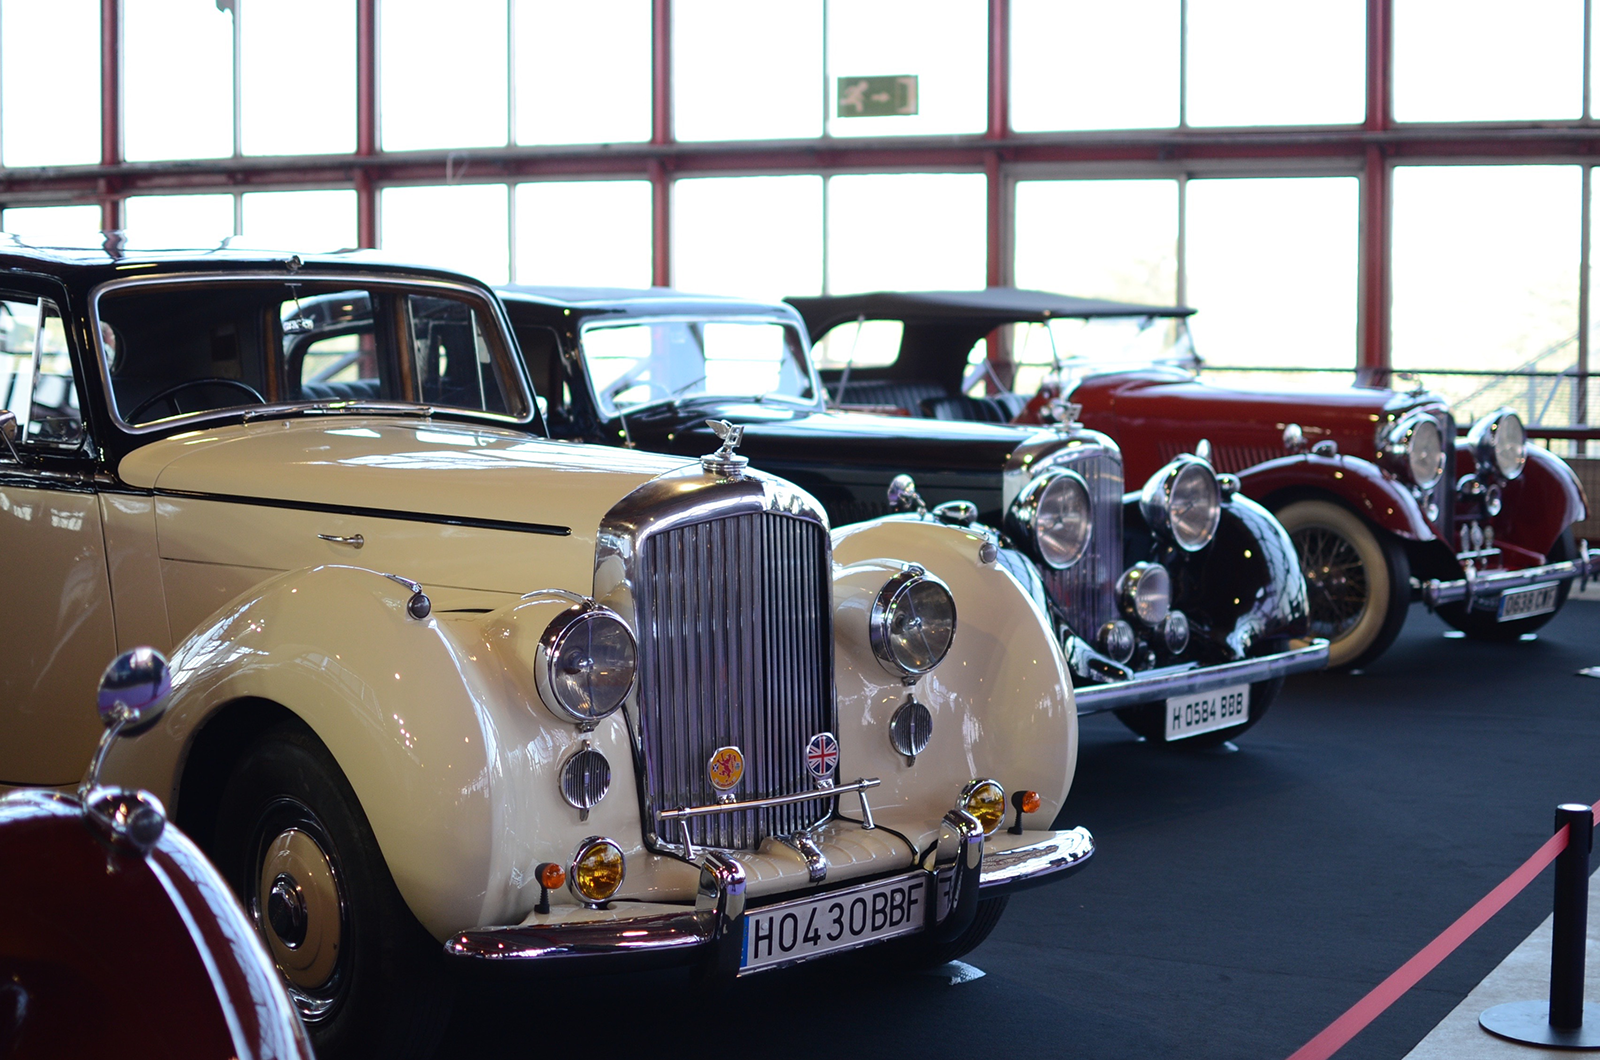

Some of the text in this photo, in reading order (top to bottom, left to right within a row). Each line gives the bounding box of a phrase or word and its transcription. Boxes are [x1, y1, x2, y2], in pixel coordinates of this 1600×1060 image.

[1172, 706, 1182, 730] H
[1185, 698, 1217, 727] 0584
[753, 882, 924, 959] H0430BBF
